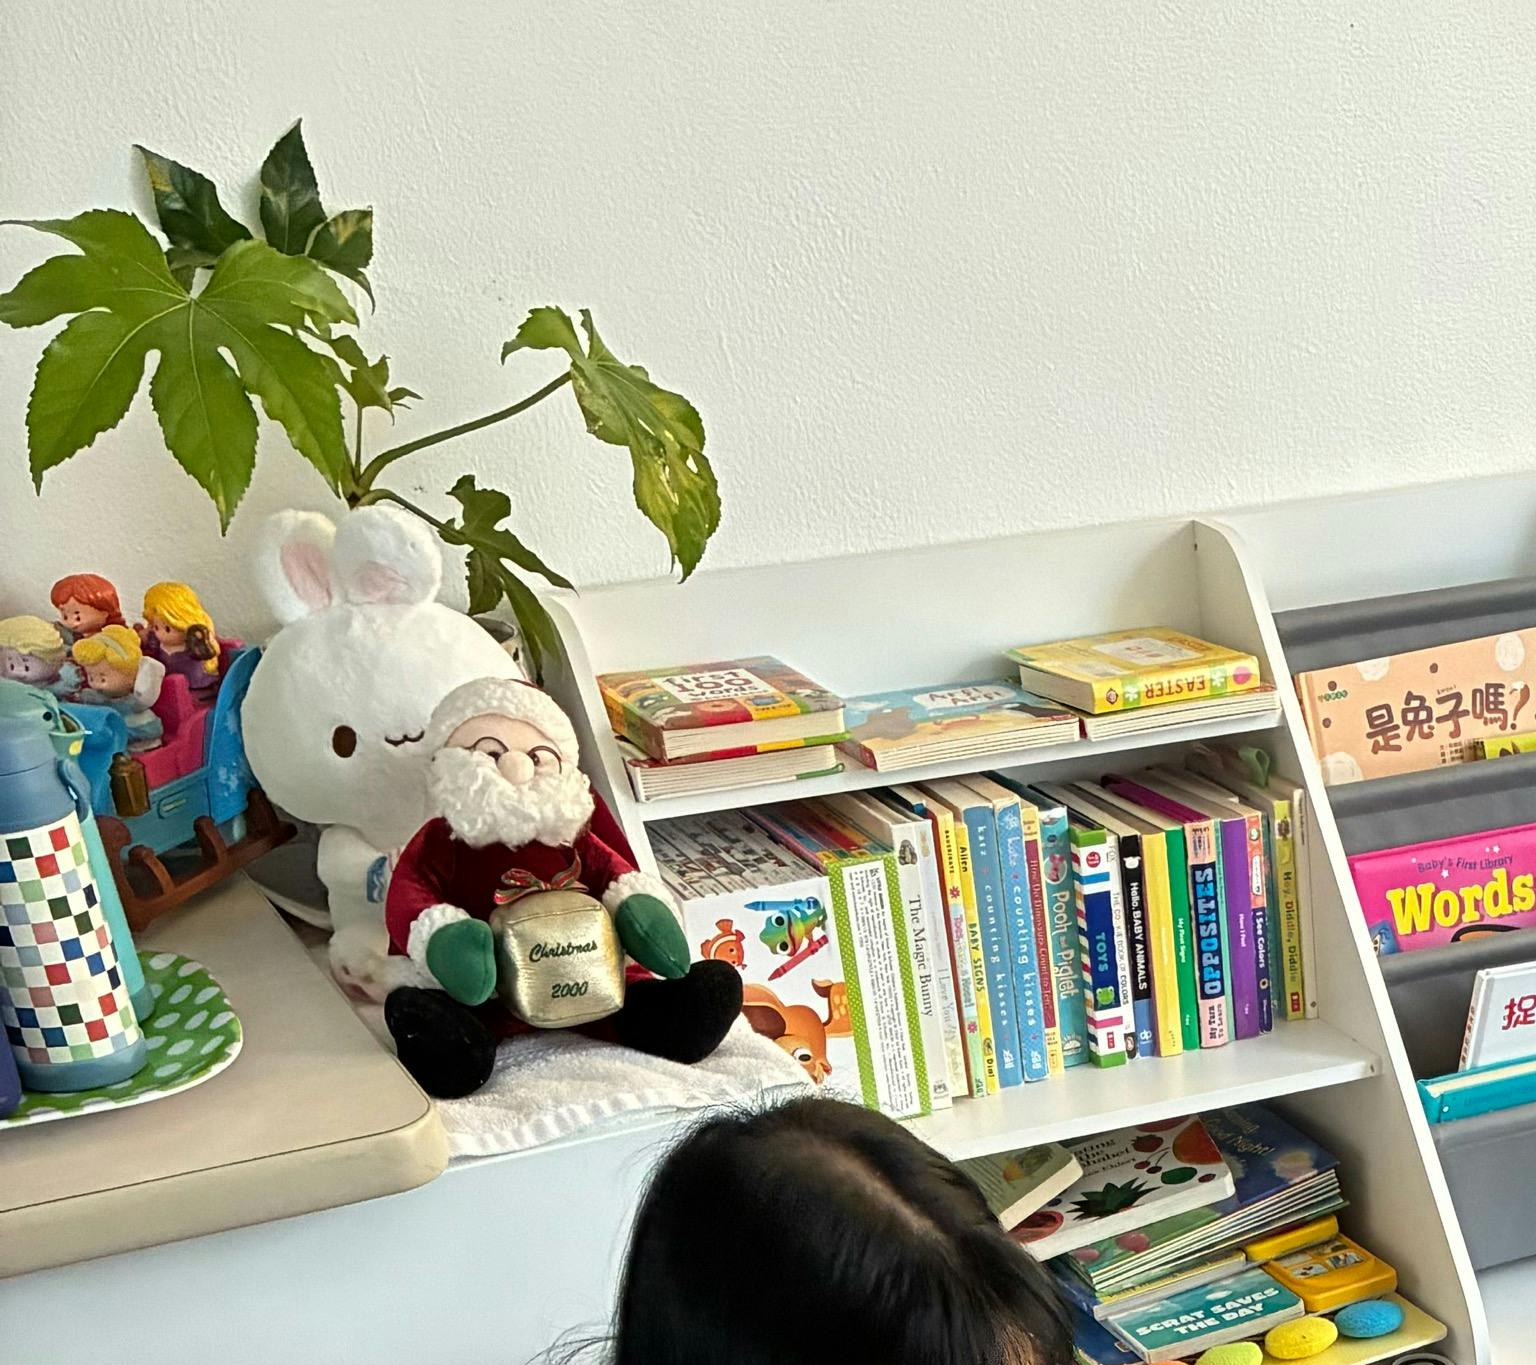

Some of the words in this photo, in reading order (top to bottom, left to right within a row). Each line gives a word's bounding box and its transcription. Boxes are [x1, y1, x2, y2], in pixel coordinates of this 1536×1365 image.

[677, 678, 753, 693] 100
[1144, 676, 1206, 699] EASTER
[1365, 681, 1531, 756] 是兔子嗎?
[959, 846, 969, 873] Allen
[1417, 857, 1453, 873] Baby's
[1456, 857, 1477, 870] First
[1479, 855, 1513, 871] Library
[909, 894, 922, 924] The
[1052, 890, 1073, 936] Pooh
[1385, 867, 1536, 936] Words
[968, 922, 980, 951] BABY
[977, 826, 988, 856] katz
[984, 884, 1000, 964] counting
[995, 973, 1008, 1026] kisses
[1132, 910, 1145, 941] BABY
[1194, 867, 1223, 996] OPPOSITES
[1256, 917, 1265, 935] See
[1285, 901, 1295, 943] Diddle,
[529, 940, 598, 963] Christmas
[912, 927, 927, 970] Magic
[1013, 885, 1029, 965] counting
[1022, 972, 1037, 1026] kisses
[1095, 932, 1109, 972] TOYS
[1257, 937, 1266, 969] Colors
[1288, 945, 1299, 983] Diddle
[973, 958, 985, 992] SIGNS
[1053, 949, 1080, 1000] Piglet
[1135, 942, 1148, 991] ANIMALS
[551, 980, 589, 998] 2000
[919, 974, 933, 1017] Bunny
[1120, 974, 1129, 1006] COLORS
[1208, 1004, 1217, 1026] Turn
[1209, 1026, 1218, 1040] My
[1135, 1309, 1206, 1337] SCRAT
[1209, 1287, 1280, 1315] SAVES
[1173, 1317, 1221, 1335] THE
[1221, 1302, 1265, 1321] DAY
